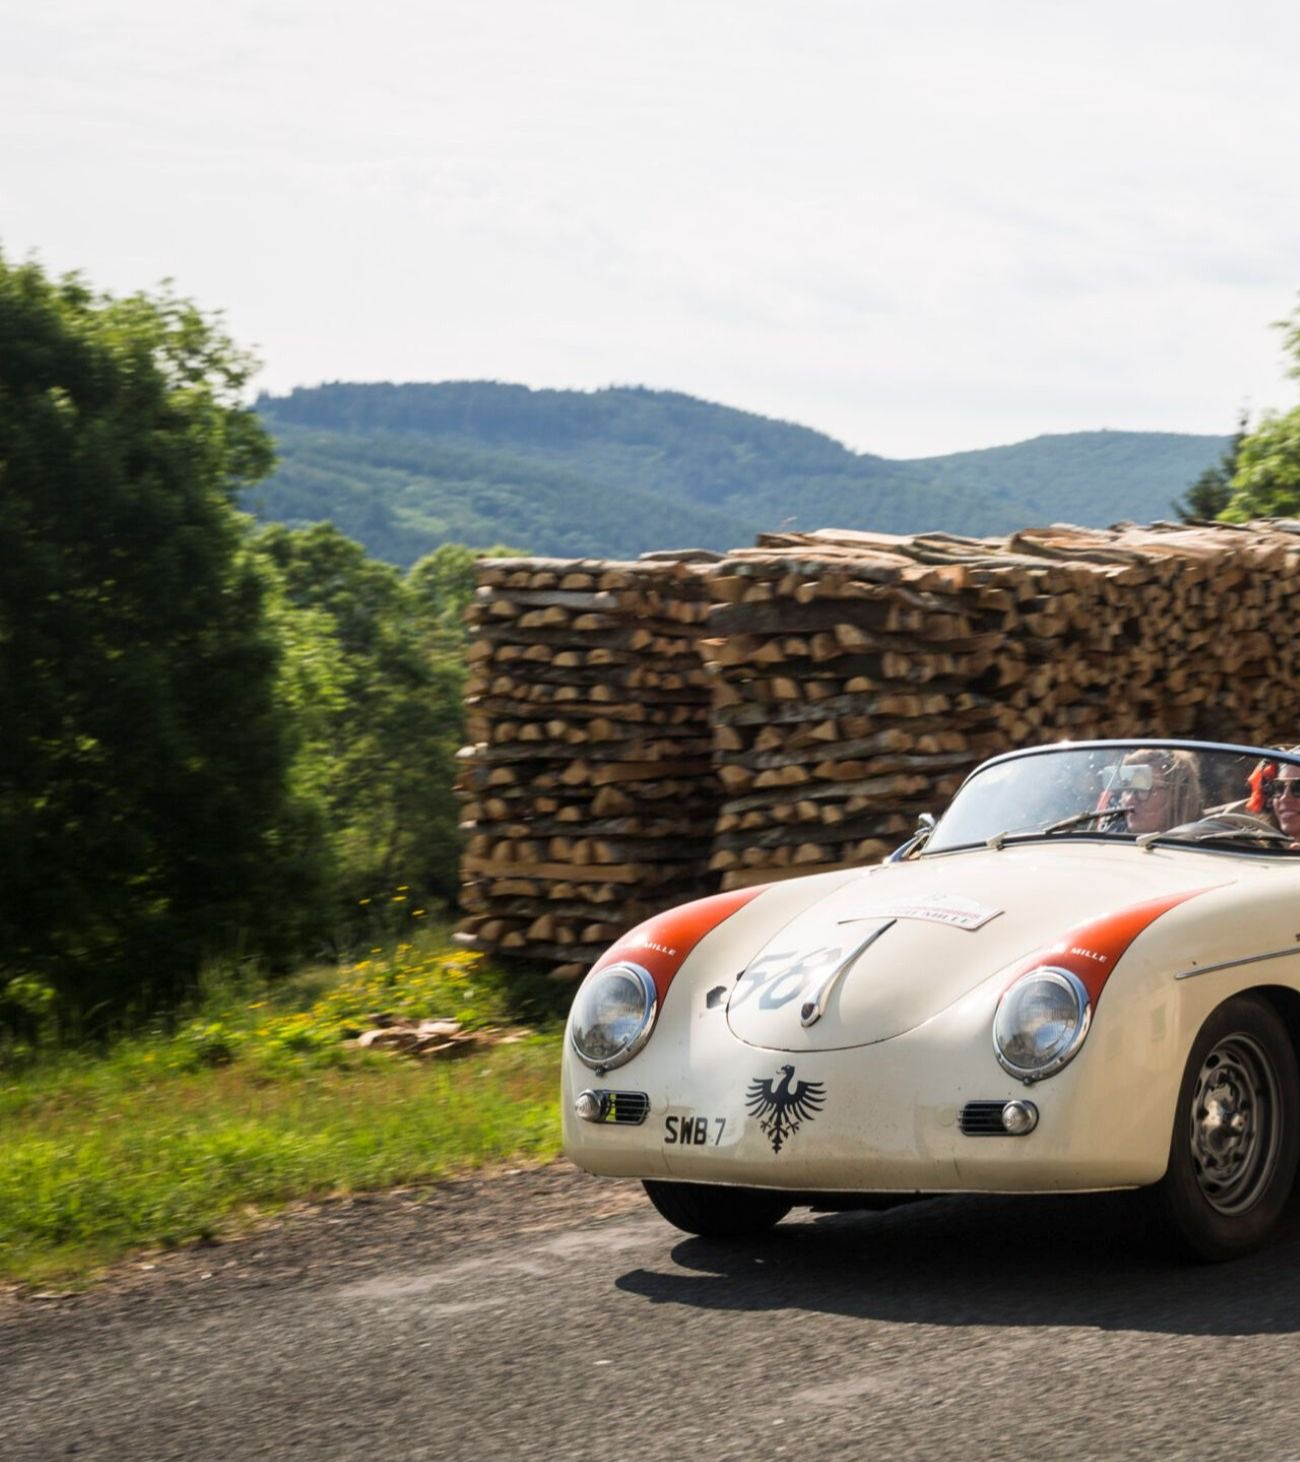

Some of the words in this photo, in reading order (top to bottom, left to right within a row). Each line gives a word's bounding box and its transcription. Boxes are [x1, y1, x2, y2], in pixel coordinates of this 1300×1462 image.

[1071, 946, 1108, 963] MILLE
[664, 1115, 708, 1145] SWB
[715, 1117, 727, 1146] 7
